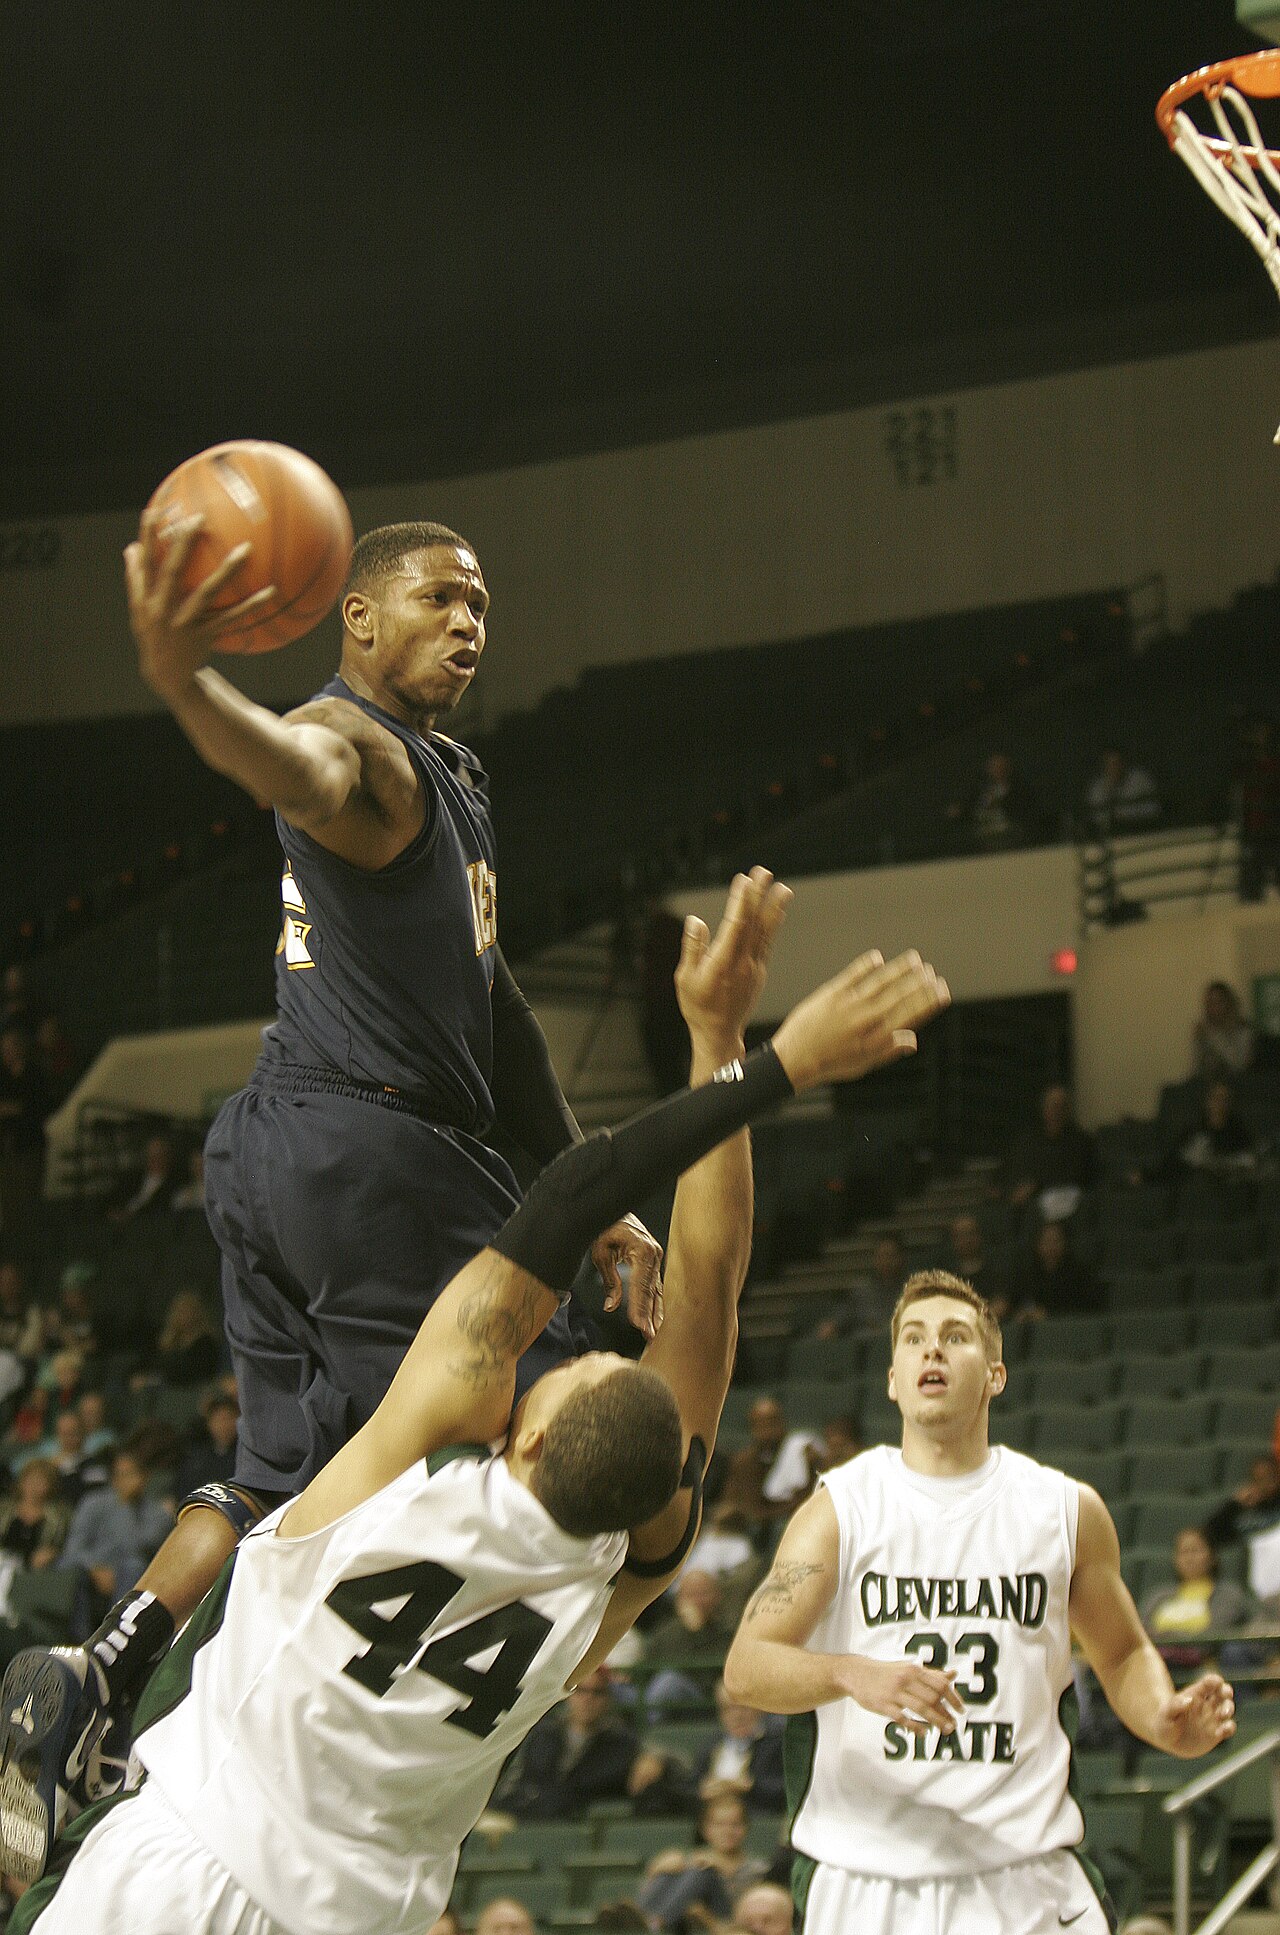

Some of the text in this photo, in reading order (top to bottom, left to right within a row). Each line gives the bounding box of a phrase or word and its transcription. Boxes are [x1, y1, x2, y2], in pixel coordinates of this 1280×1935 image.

[860, 1571, 1048, 1629] CLEVELAND
[324, 1560, 555, 1739] 44
[904, 1632, 1000, 1706] 33
[883, 1721, 1016, 1764] STATE
